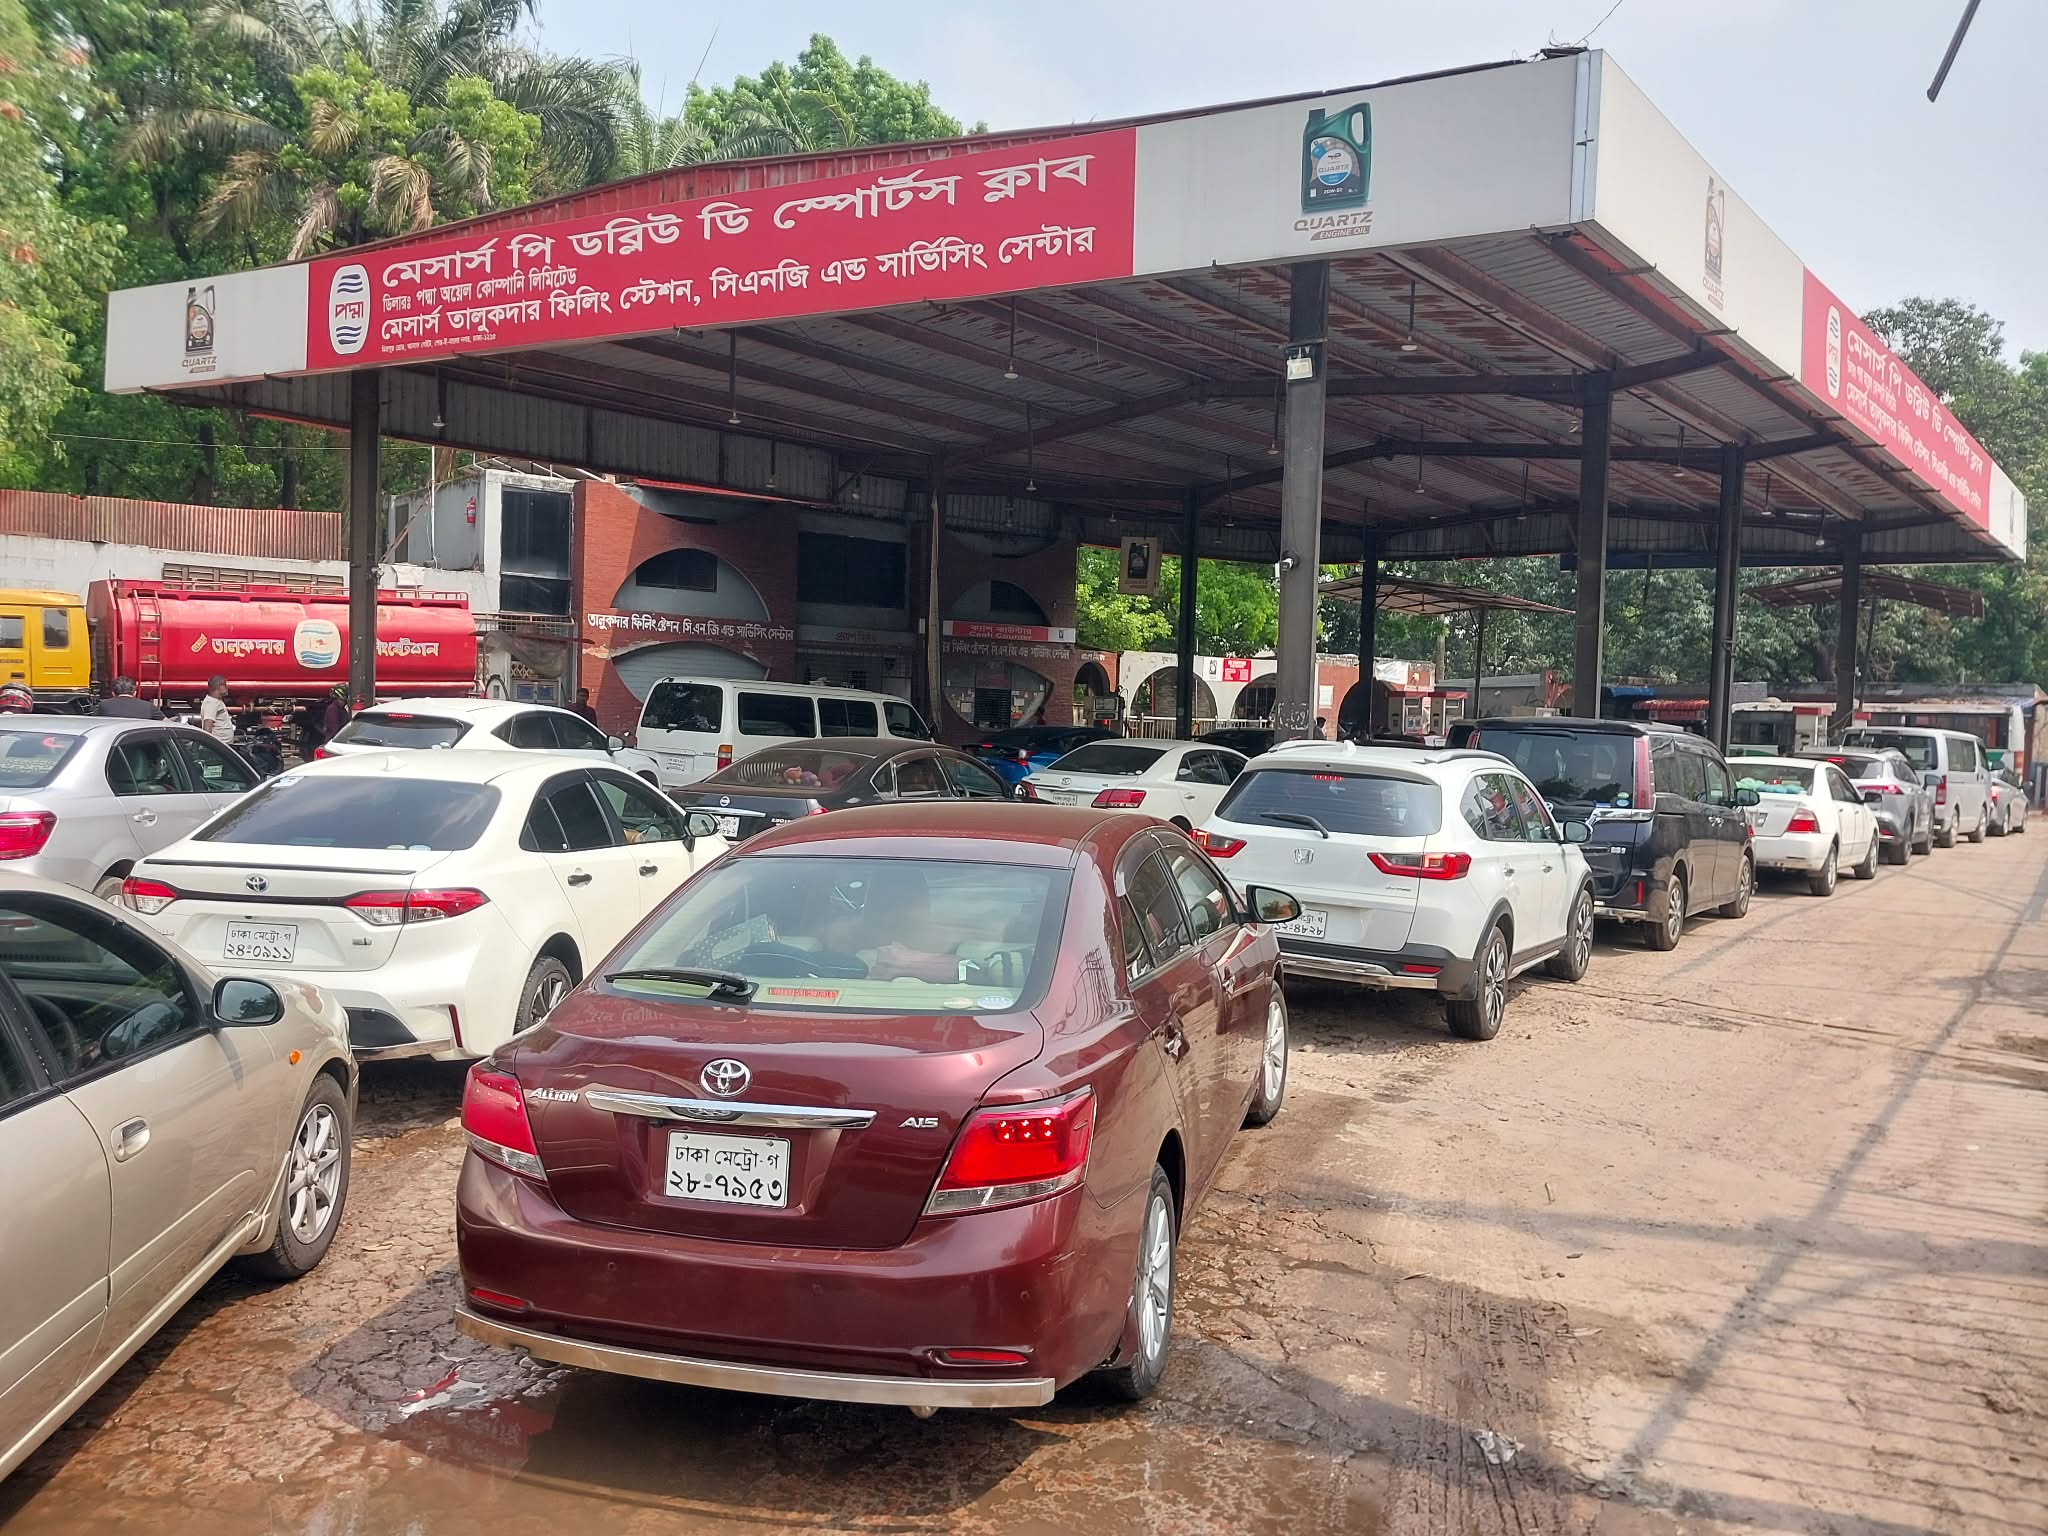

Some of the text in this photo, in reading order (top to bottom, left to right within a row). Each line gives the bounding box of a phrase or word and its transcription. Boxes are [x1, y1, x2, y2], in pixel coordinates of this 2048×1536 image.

[382, 237, 499, 288] মেসার্স
[507, 233, 555, 269] পি
[696, 202, 753, 240] ডি
[773, 168, 963, 229] স্পোর্টস
[977, 154, 1096, 202] ক্লাব
[1294, 211, 1374, 231] QUARTZ
[1320, 226, 1368, 239] ENGINE OIL
[381, 305, 442, 340] মেসার্স
[446, 299, 542, 332] তালুকদার
[547, 285, 612, 319] ফিলিং
[709, 258, 810, 300] সিএনজি
[820, 257, 868, 285] এন্ড
[875, 236, 988, 278] সার্ভিসিং
[999, 223, 1097, 264] সেন্টার
[416, 287, 437, 308] পদ্মা
[440, 282, 472, 303] অয়েল
[476, 269, 526, 298] কোম্পানি
[528, 264, 577, 291] লিমিটেড
[335, 301, 364, 322] পদ্মা
[182, 356, 217, 368] QUARTZ
[1847, 330, 1888, 380] মেসার্স
[1889, 361, 1902, 396] পি
[587, 612, 629, 631] তালুকদার
[631, 613, 657, 631] ফিলিং
[736, 622, 769, 640] সার্ভিসিং
[768, 626, 794, 641] সেন্টার
[995, 632, 1033, 641] Counter
[212, 637, 286, 658] তালুকদার
[231, 930, 251, 939] ঢাকা
[226, 943, 292, 959] ২৪-০৯১১
[528, 1087, 579, 1102] ALLION
[899, 1116, 939, 1128] A15
[675, 1146, 710, 1163] ঢাকা
[669, 1170, 782, 1201] ২৮-৭৯৫৩
